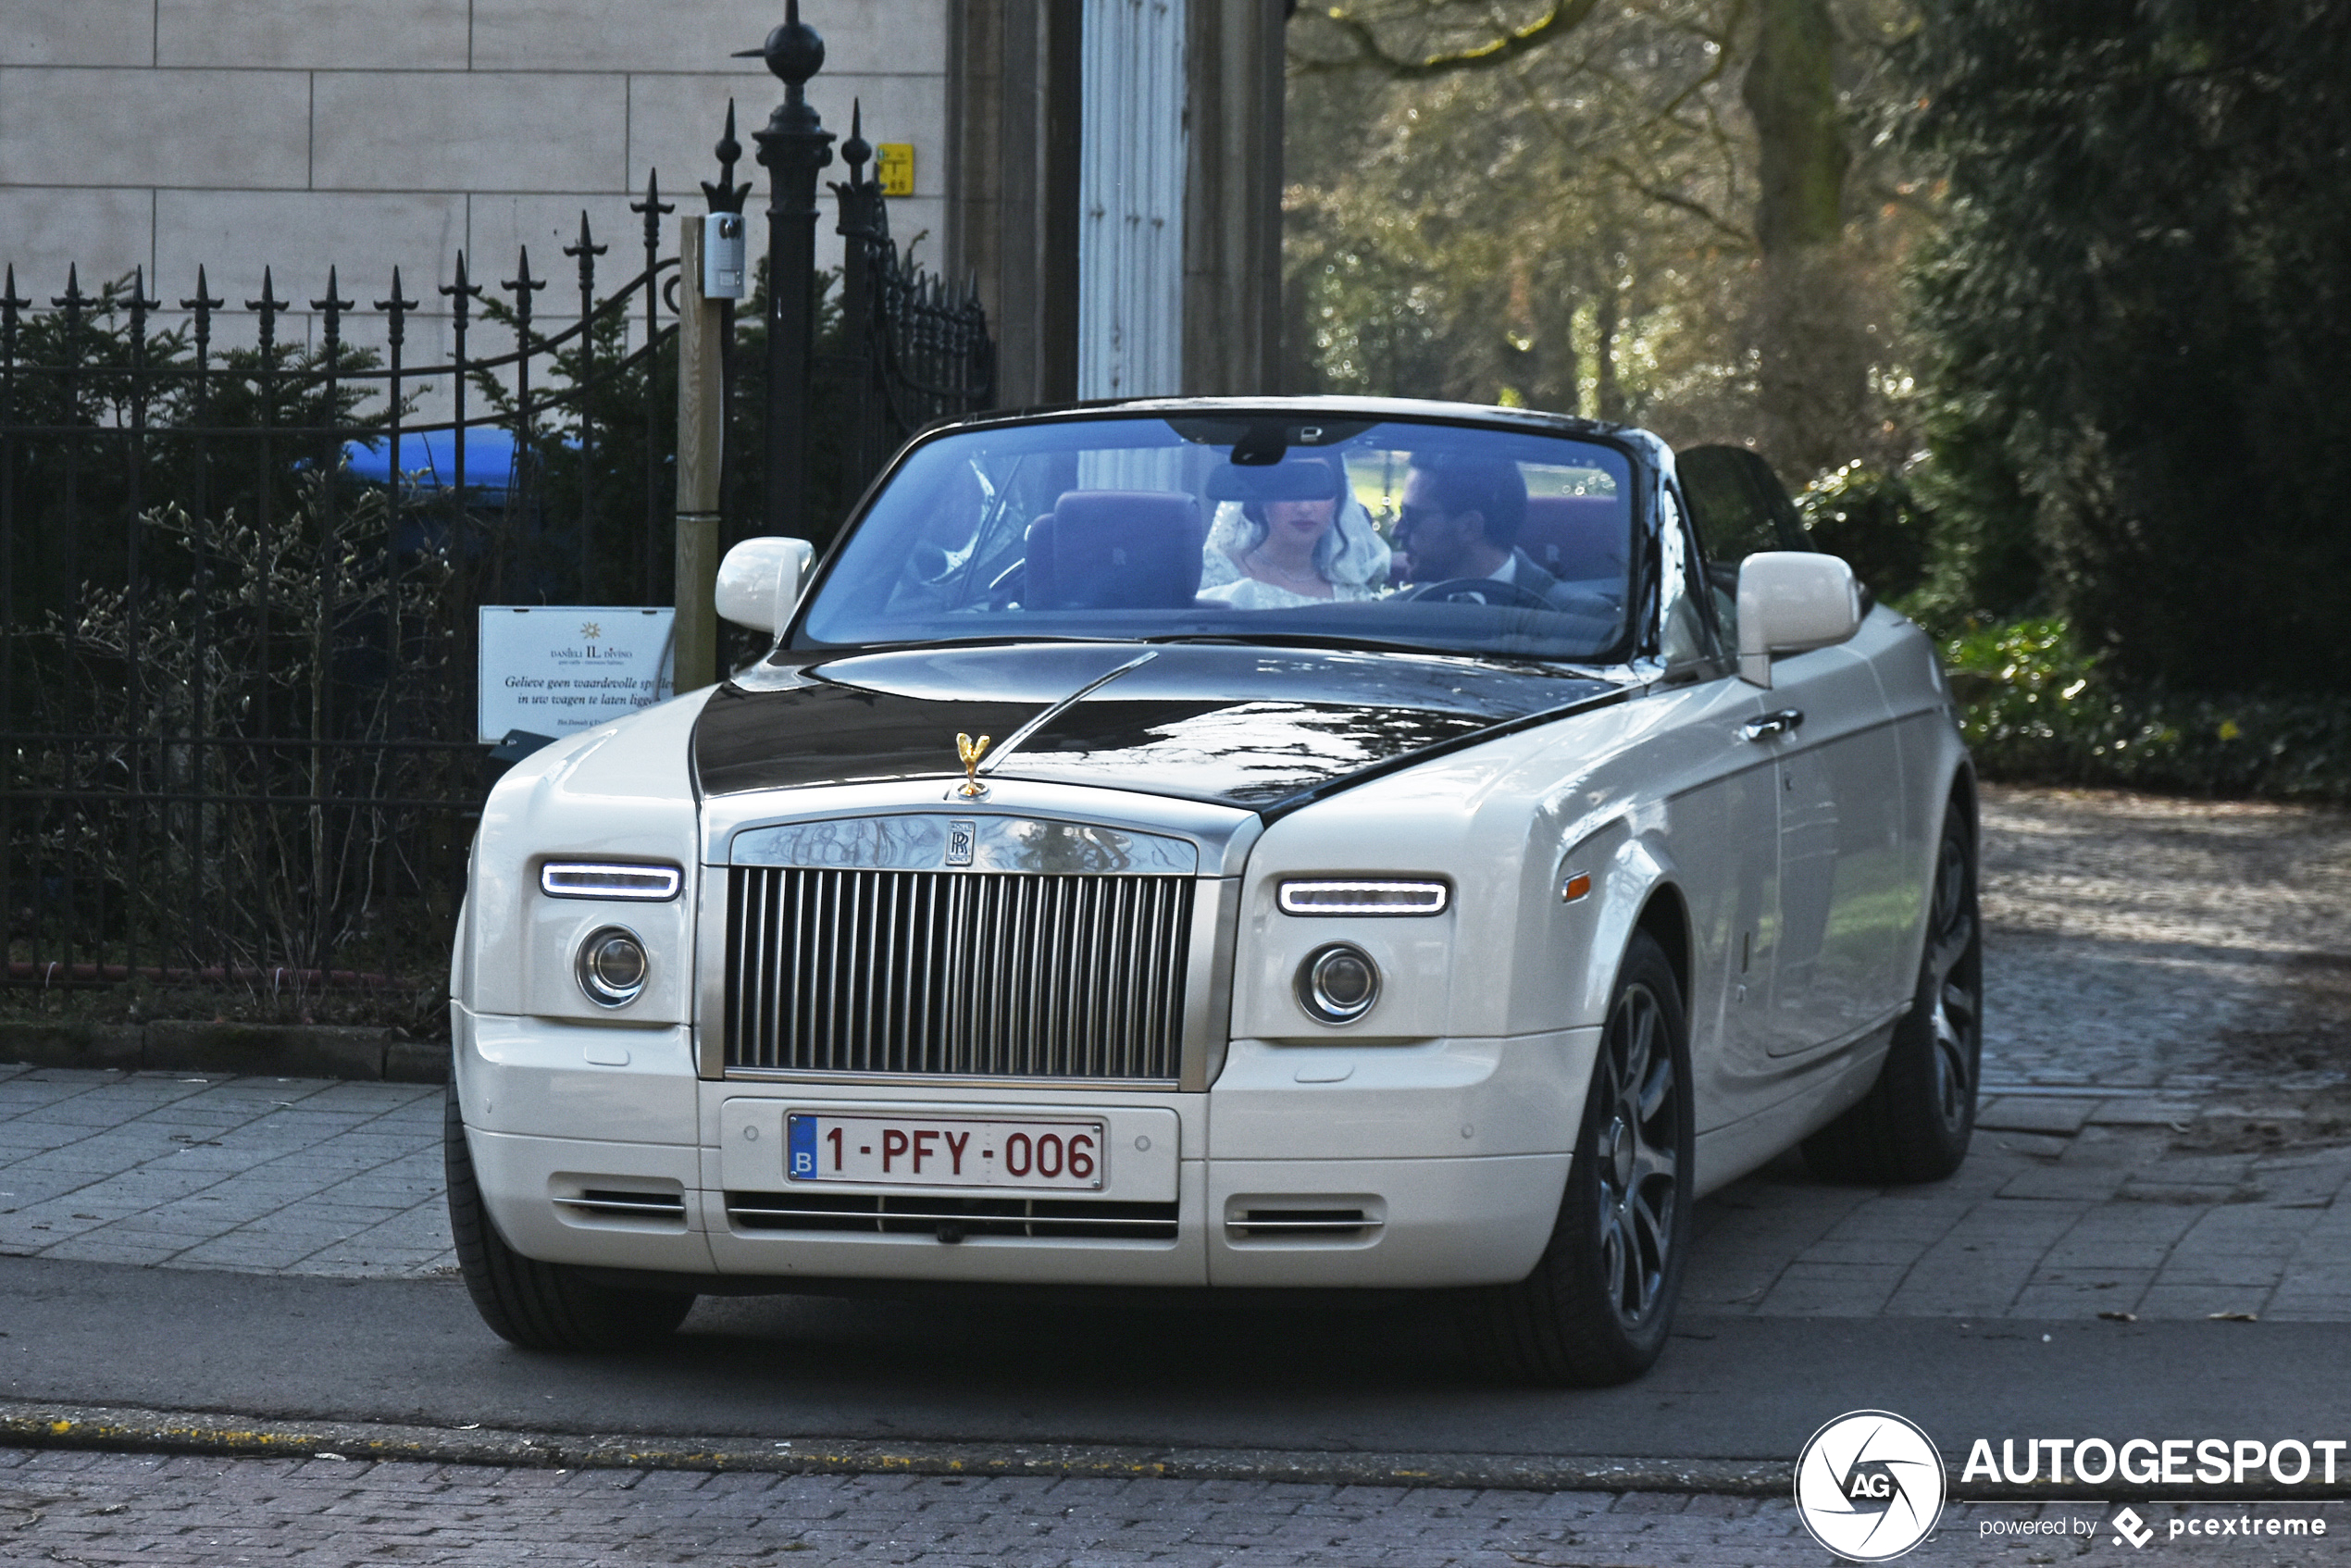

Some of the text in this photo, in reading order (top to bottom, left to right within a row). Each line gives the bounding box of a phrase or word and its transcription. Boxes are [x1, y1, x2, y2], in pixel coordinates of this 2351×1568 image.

[504, 676, 544, 688] Gelieve
[547, 678, 570, 690] geen
[574, 677, 637, 689] waardevolle
[517, 692, 529, 704] in
[531, 695, 548, 704] uw
[552, 695, 585, 706] wagen
[589, 694, 599, 704] te
[601, 693, 627, 704] laten
[796, 1152, 812, 1172] B
